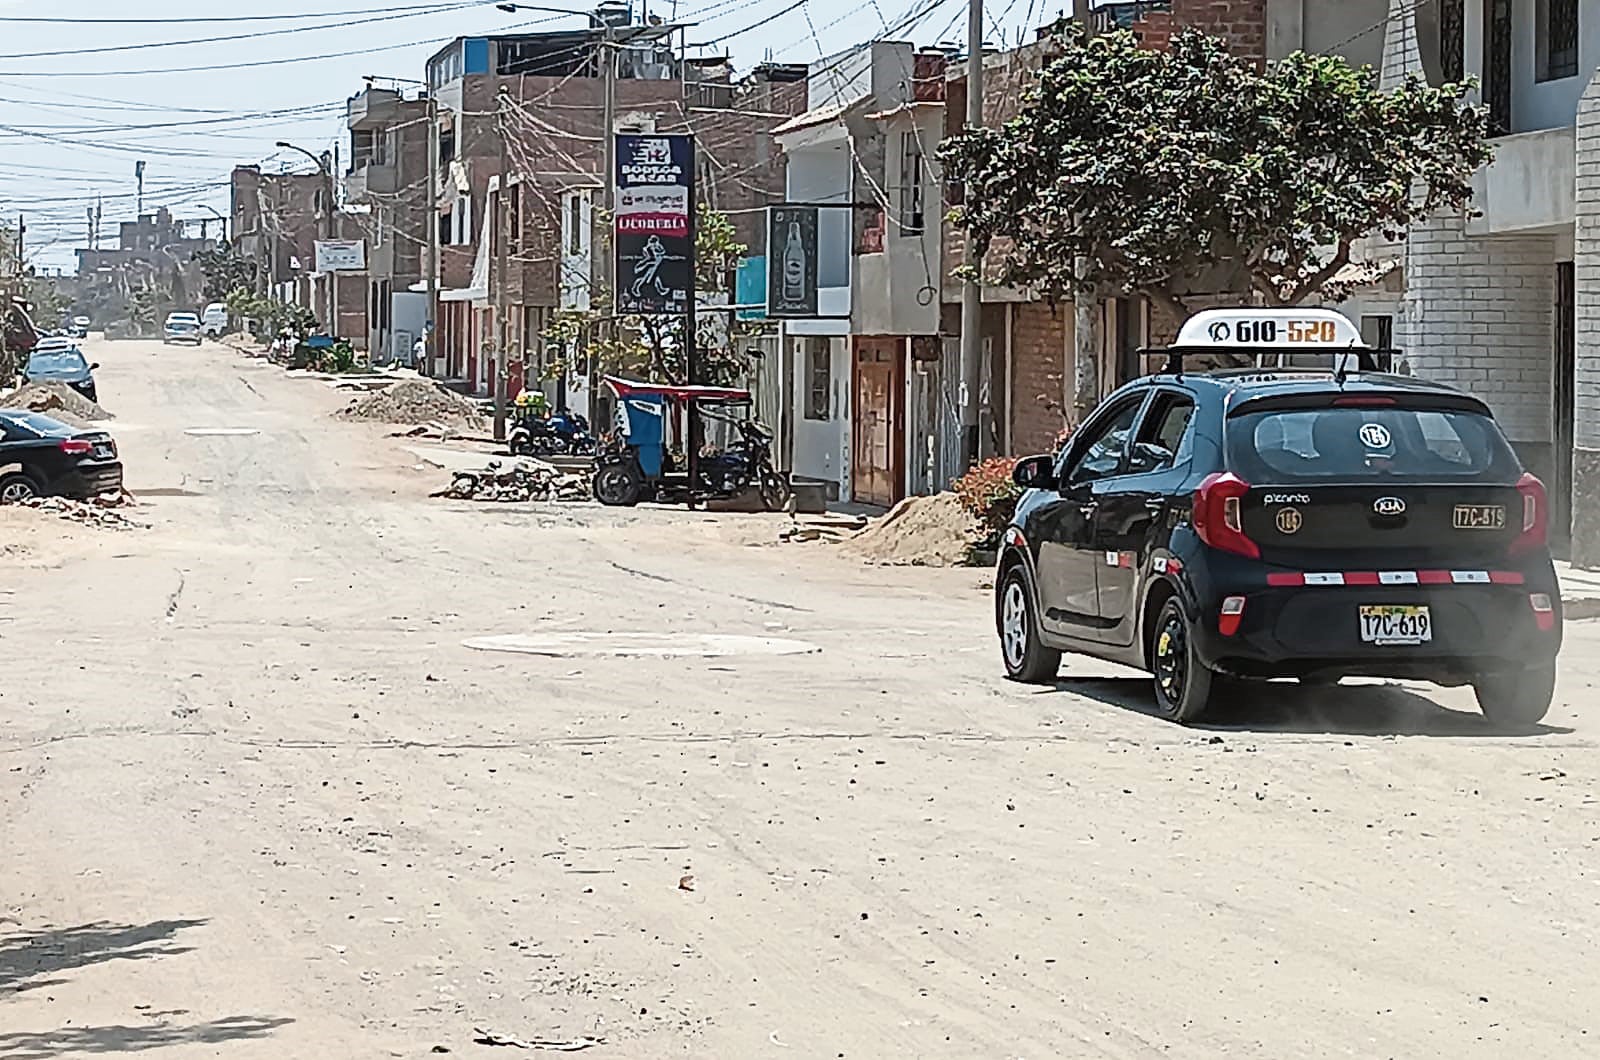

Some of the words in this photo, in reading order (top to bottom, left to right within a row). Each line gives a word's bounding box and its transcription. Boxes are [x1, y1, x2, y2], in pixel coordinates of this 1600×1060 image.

[1236, 320, 1336, 342] 610-520
[1379, 501, 1401, 512] KIA
[1362, 614, 1428, 637] T7C-619
